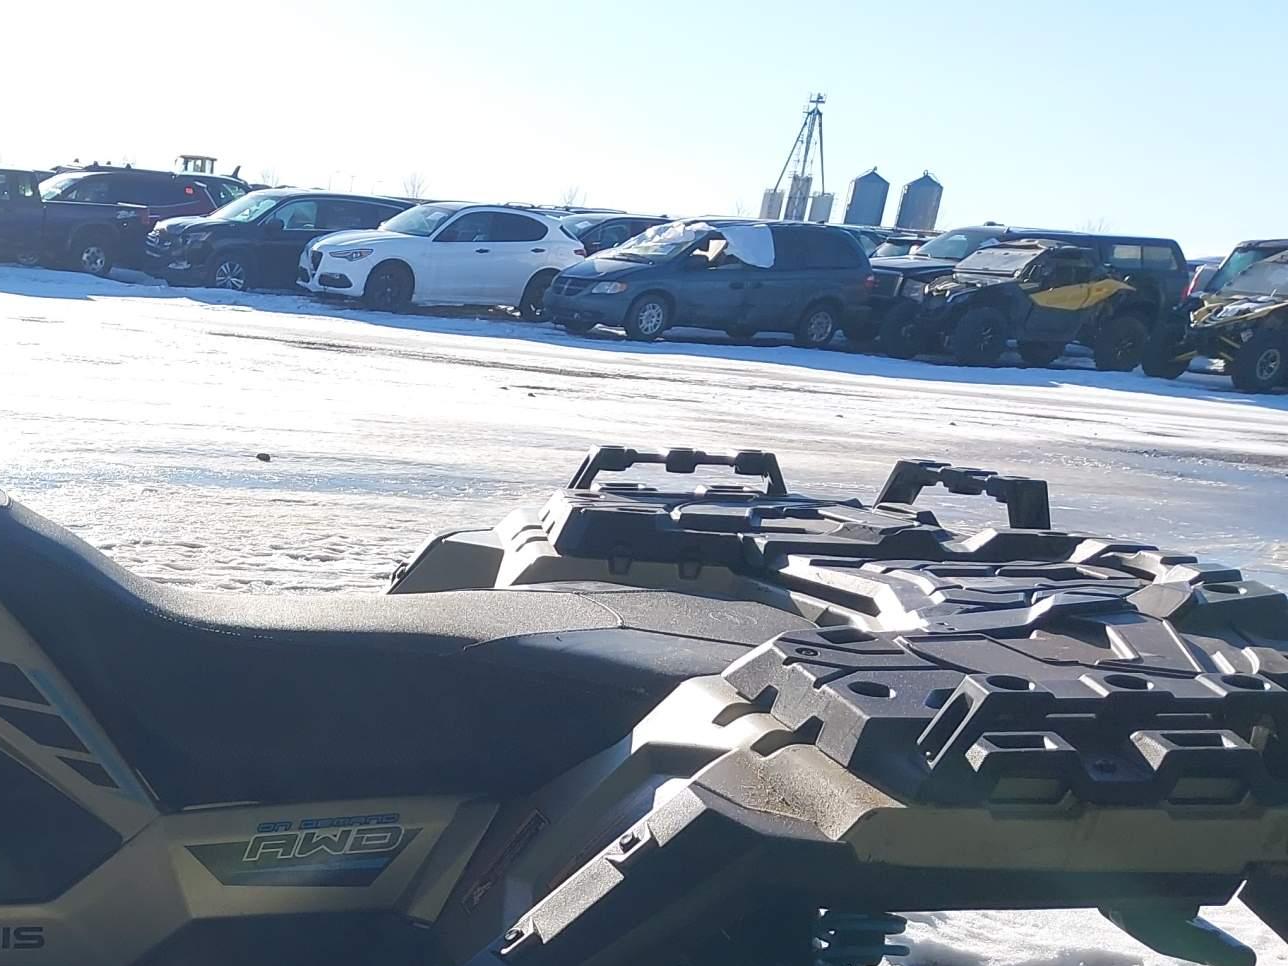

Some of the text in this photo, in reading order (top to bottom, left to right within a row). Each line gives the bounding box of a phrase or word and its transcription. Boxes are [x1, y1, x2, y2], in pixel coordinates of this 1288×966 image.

[256, 812, 401, 833] ON DEMAND
[242, 823, 405, 862] AWD
